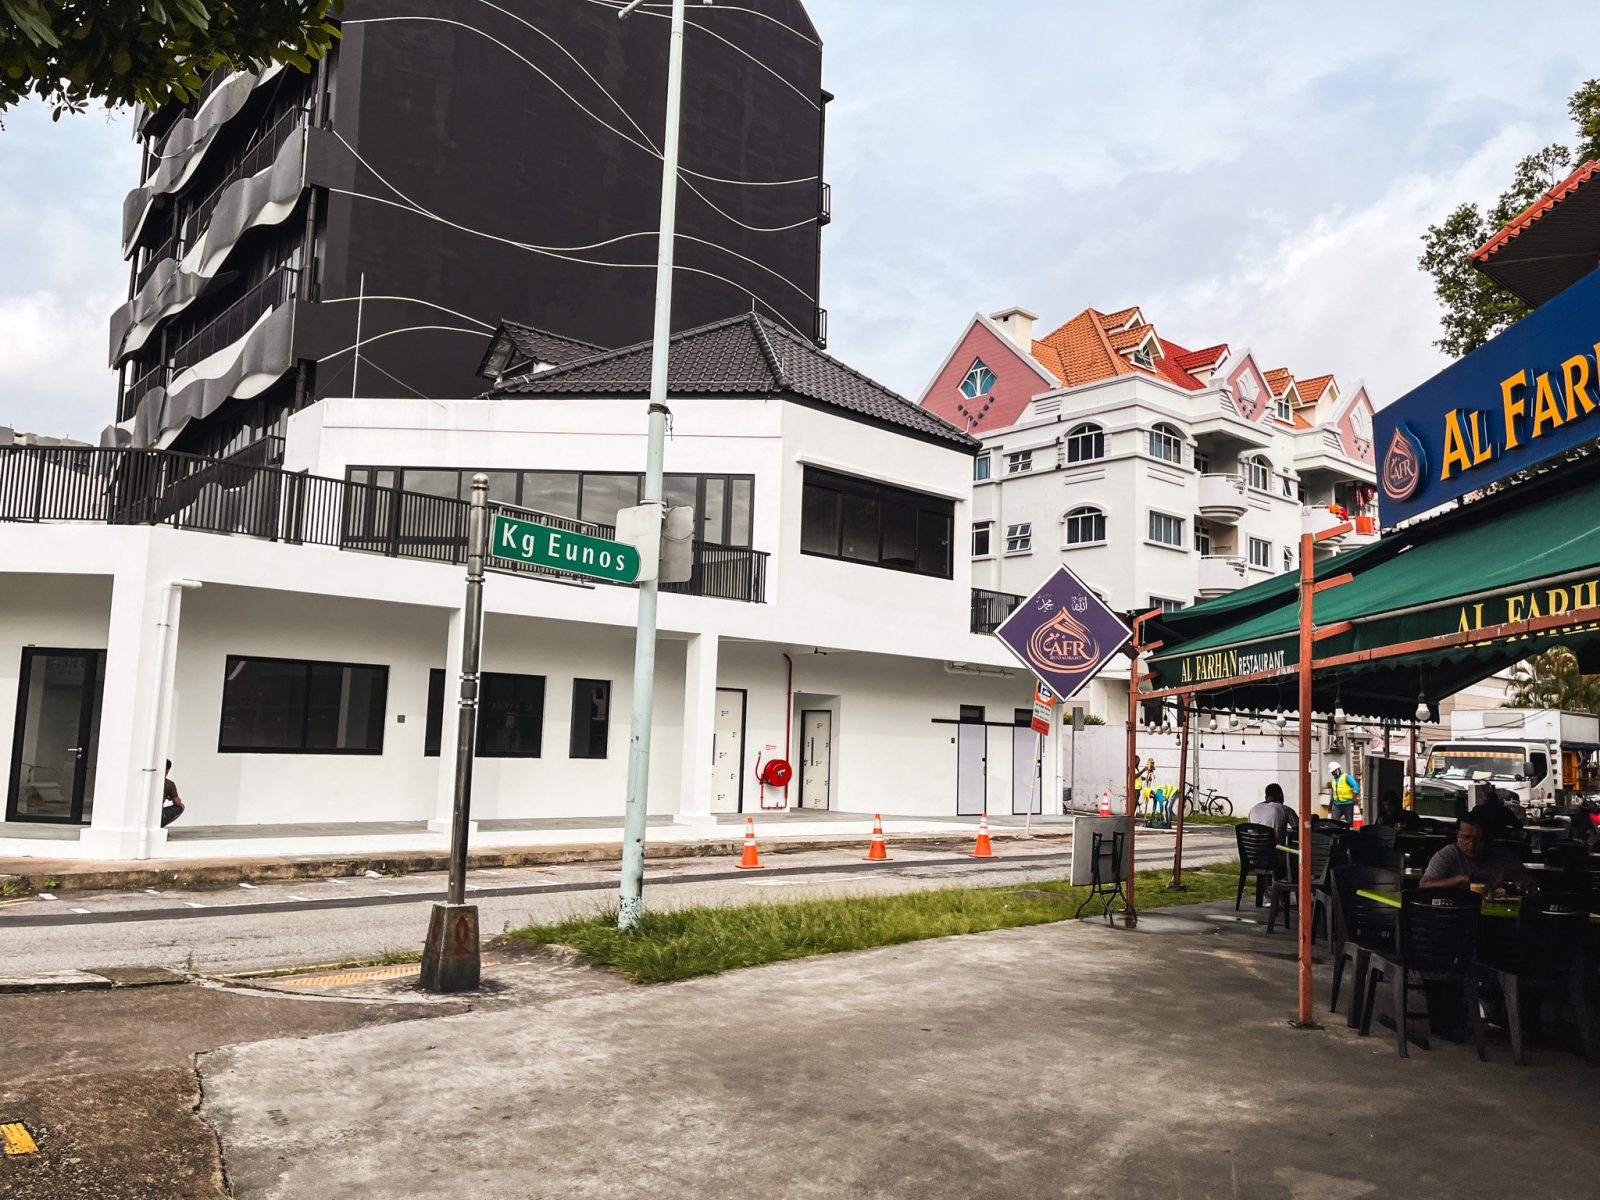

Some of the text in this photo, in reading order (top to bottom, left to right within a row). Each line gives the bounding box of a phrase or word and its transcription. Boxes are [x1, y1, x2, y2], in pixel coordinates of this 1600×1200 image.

[1440, 408, 1492, 481] AL
[502, 522, 625, 571] Kg Eunos
[1182, 650, 1285, 682] AL FARHAN RESTAURANT
